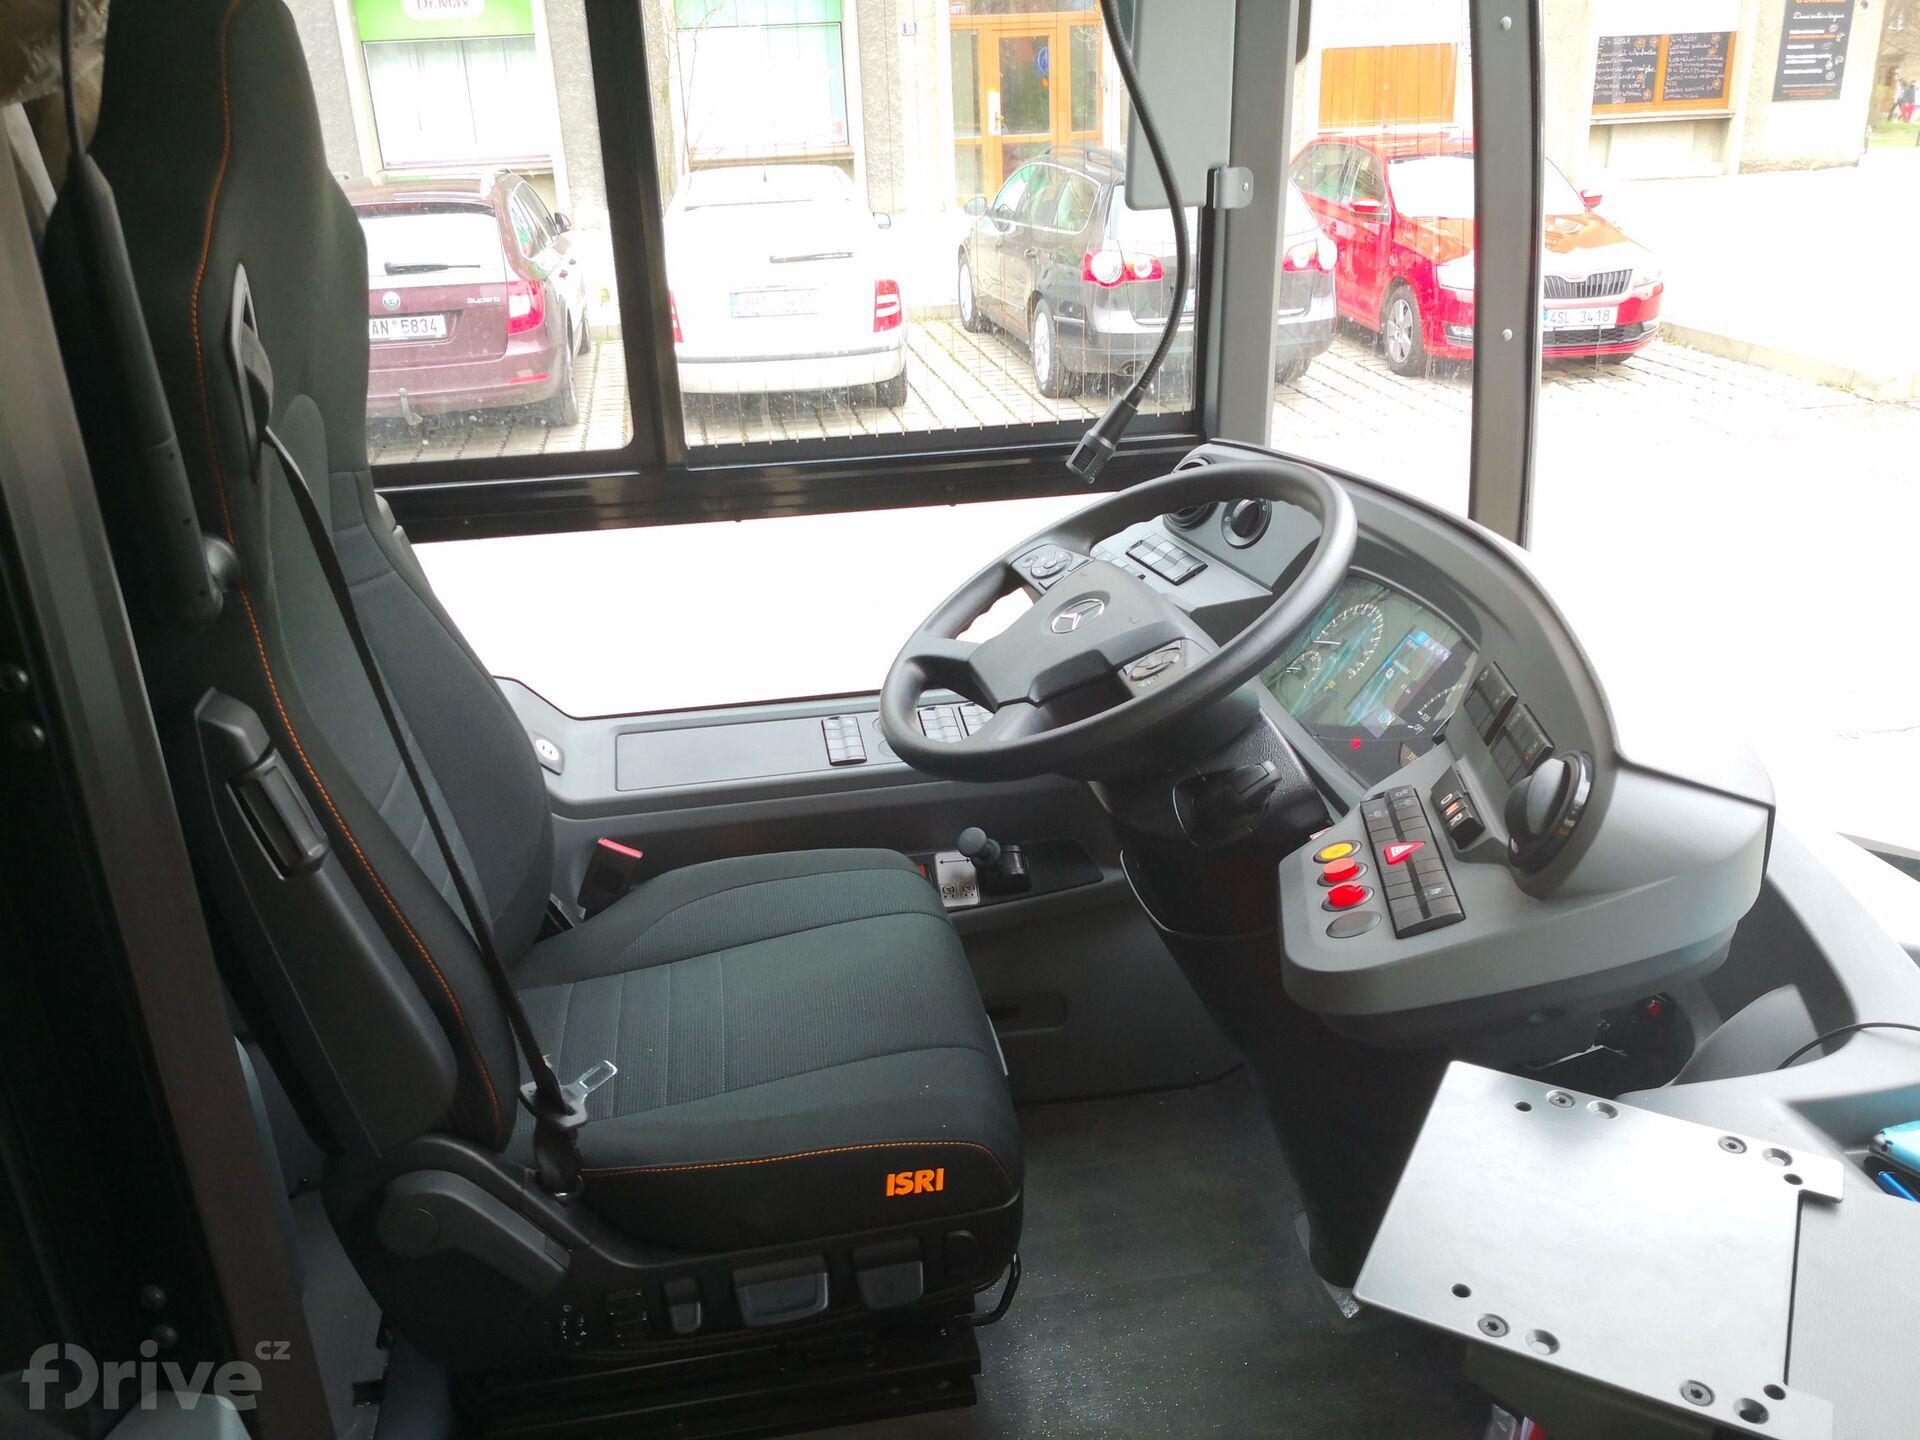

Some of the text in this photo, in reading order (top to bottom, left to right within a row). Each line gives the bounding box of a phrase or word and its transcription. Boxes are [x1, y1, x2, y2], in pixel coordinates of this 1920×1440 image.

[466, 296, 501, 305] Superb
[1550, 309, 1610, 324] 4SL 3418
[400, 317, 438, 334] 5834
[1450, 812, 1463, 826] R
[886, 1167, 945, 1197] ISRI
